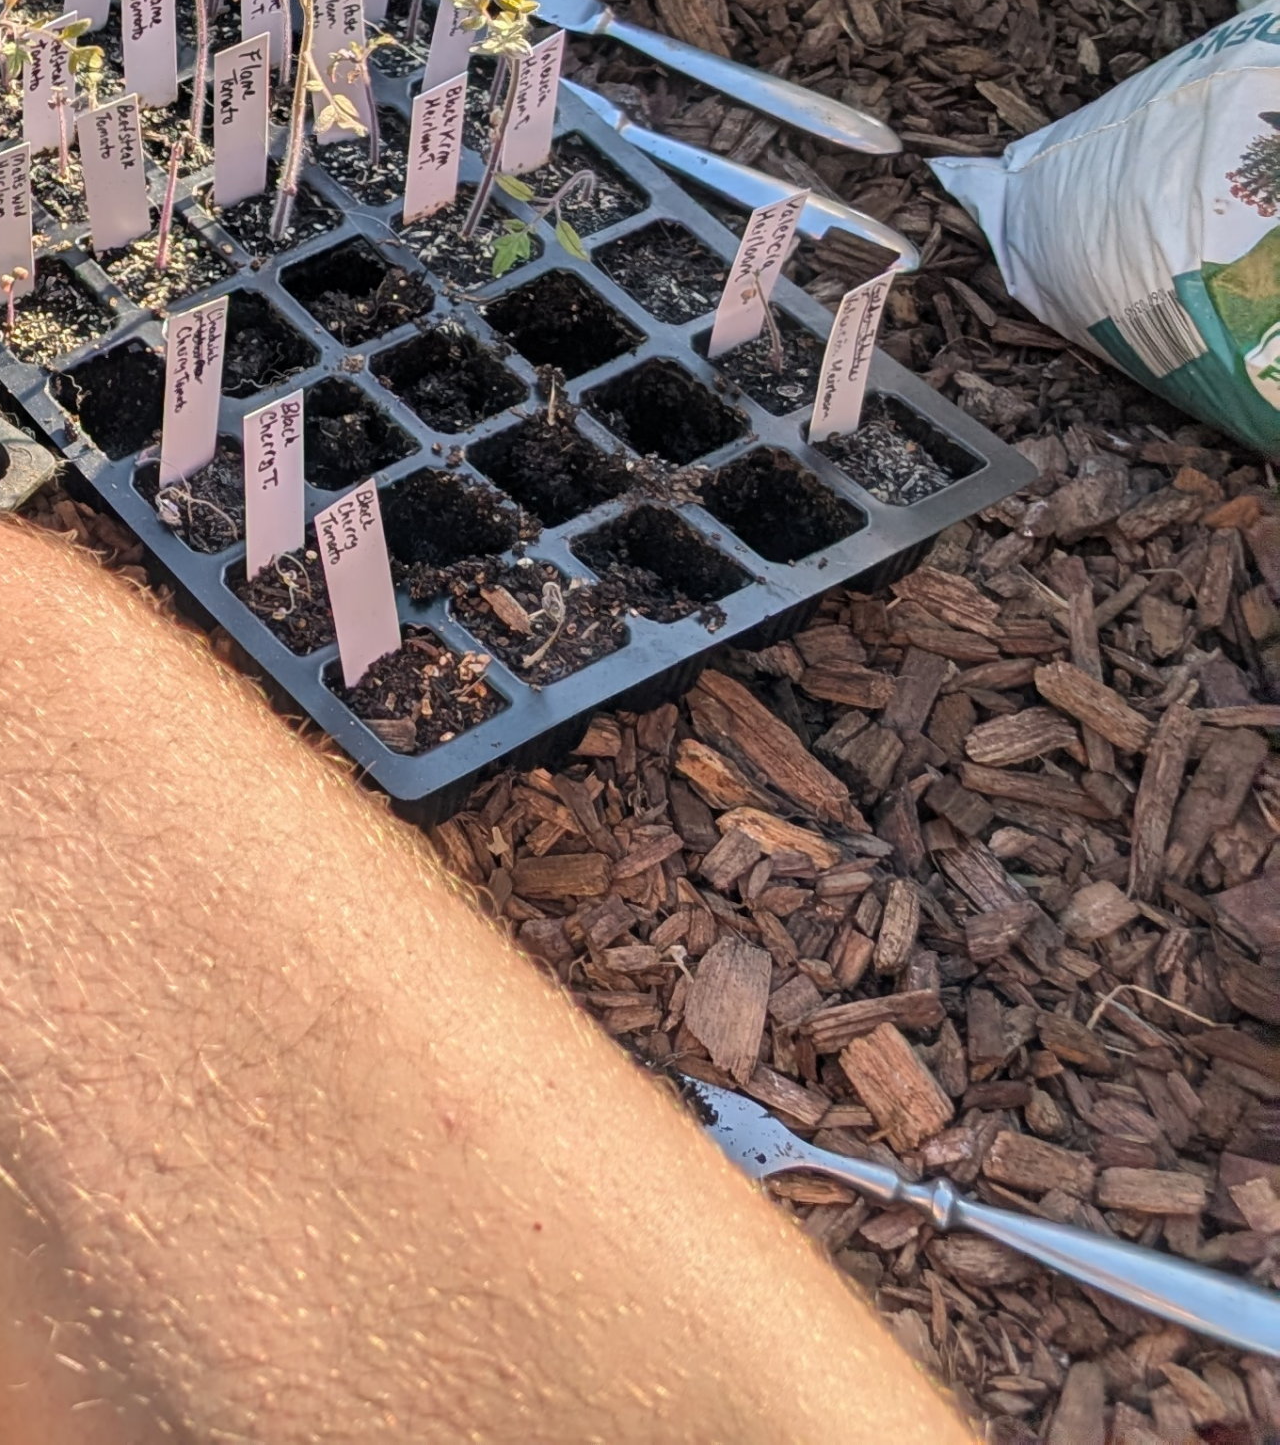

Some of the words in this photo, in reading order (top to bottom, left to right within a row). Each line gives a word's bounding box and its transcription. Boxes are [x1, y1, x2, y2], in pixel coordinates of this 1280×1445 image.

[95, 112, 116, 160] Tomato
[762, 196, 801, 272] Valencia
[257, 410, 277, 479] Cherry
[278, 401, 302, 449] Black
[336, 500, 359, 552] Cherry
[354, 488, 377, 532] Black
[319, 515, 341, 567] Tomato
